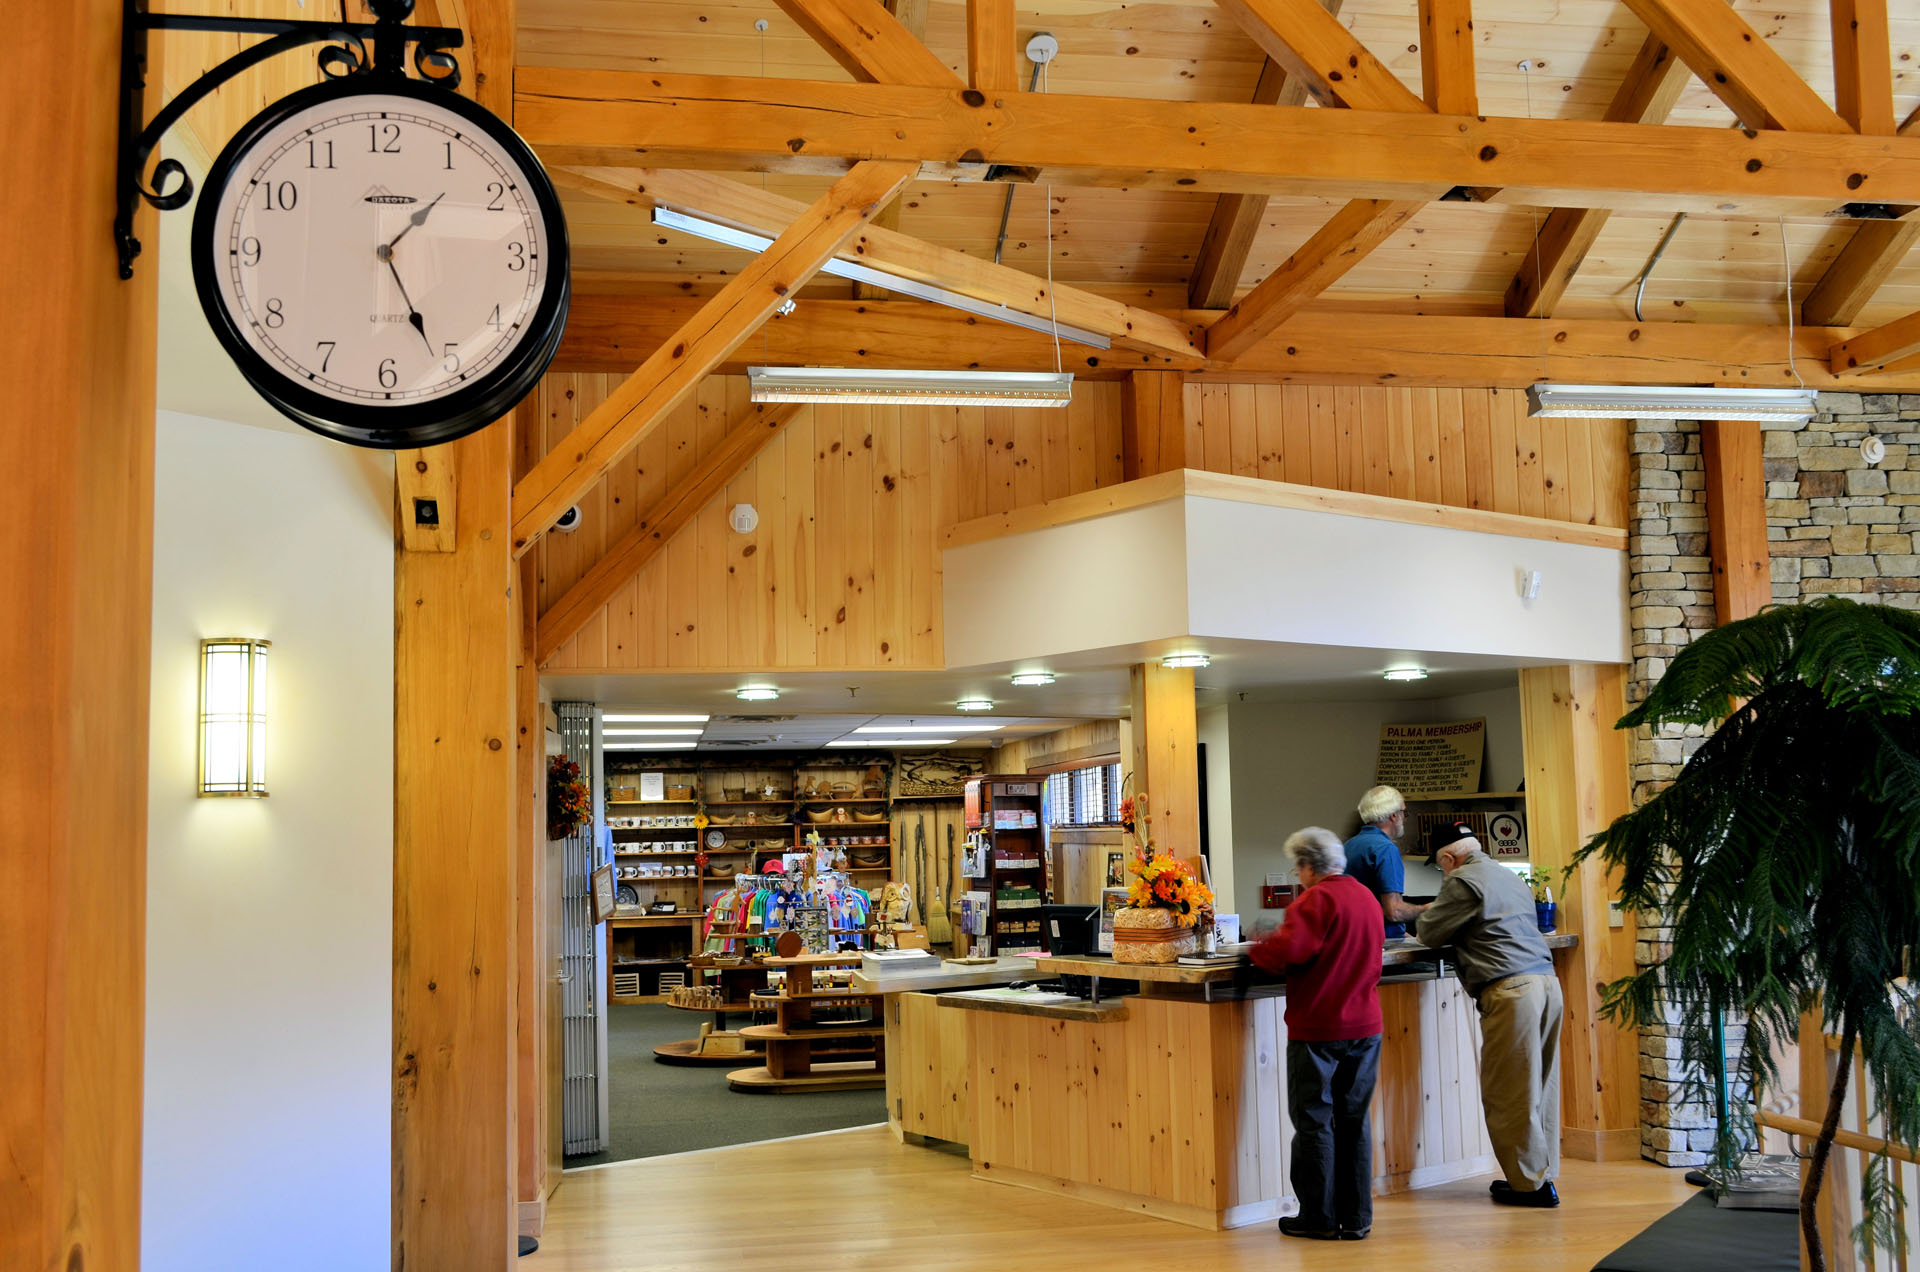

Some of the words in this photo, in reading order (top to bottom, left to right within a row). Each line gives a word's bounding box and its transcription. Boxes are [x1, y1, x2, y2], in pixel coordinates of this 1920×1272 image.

[367, 124, 401, 153] 12
[305, 140, 336, 169] 11
[443, 142, 456, 170] 1
[262, 181, 297, 211] 10
[487, 182, 505, 211] 2
[242, 237, 261, 267] 9
[508, 243, 525, 271] 3
[265, 298, 284, 329] 8
[370, 314, 405, 323] QUARTZ
[487, 304, 505, 333] 4
[317, 342, 336, 373] 7
[443, 343, 460, 373] 5
[378, 359, 397, 388] 6
[1387, 727, 1423, 737] PALMA
[1425, 721, 1482, 737] MEMBERSHIP
